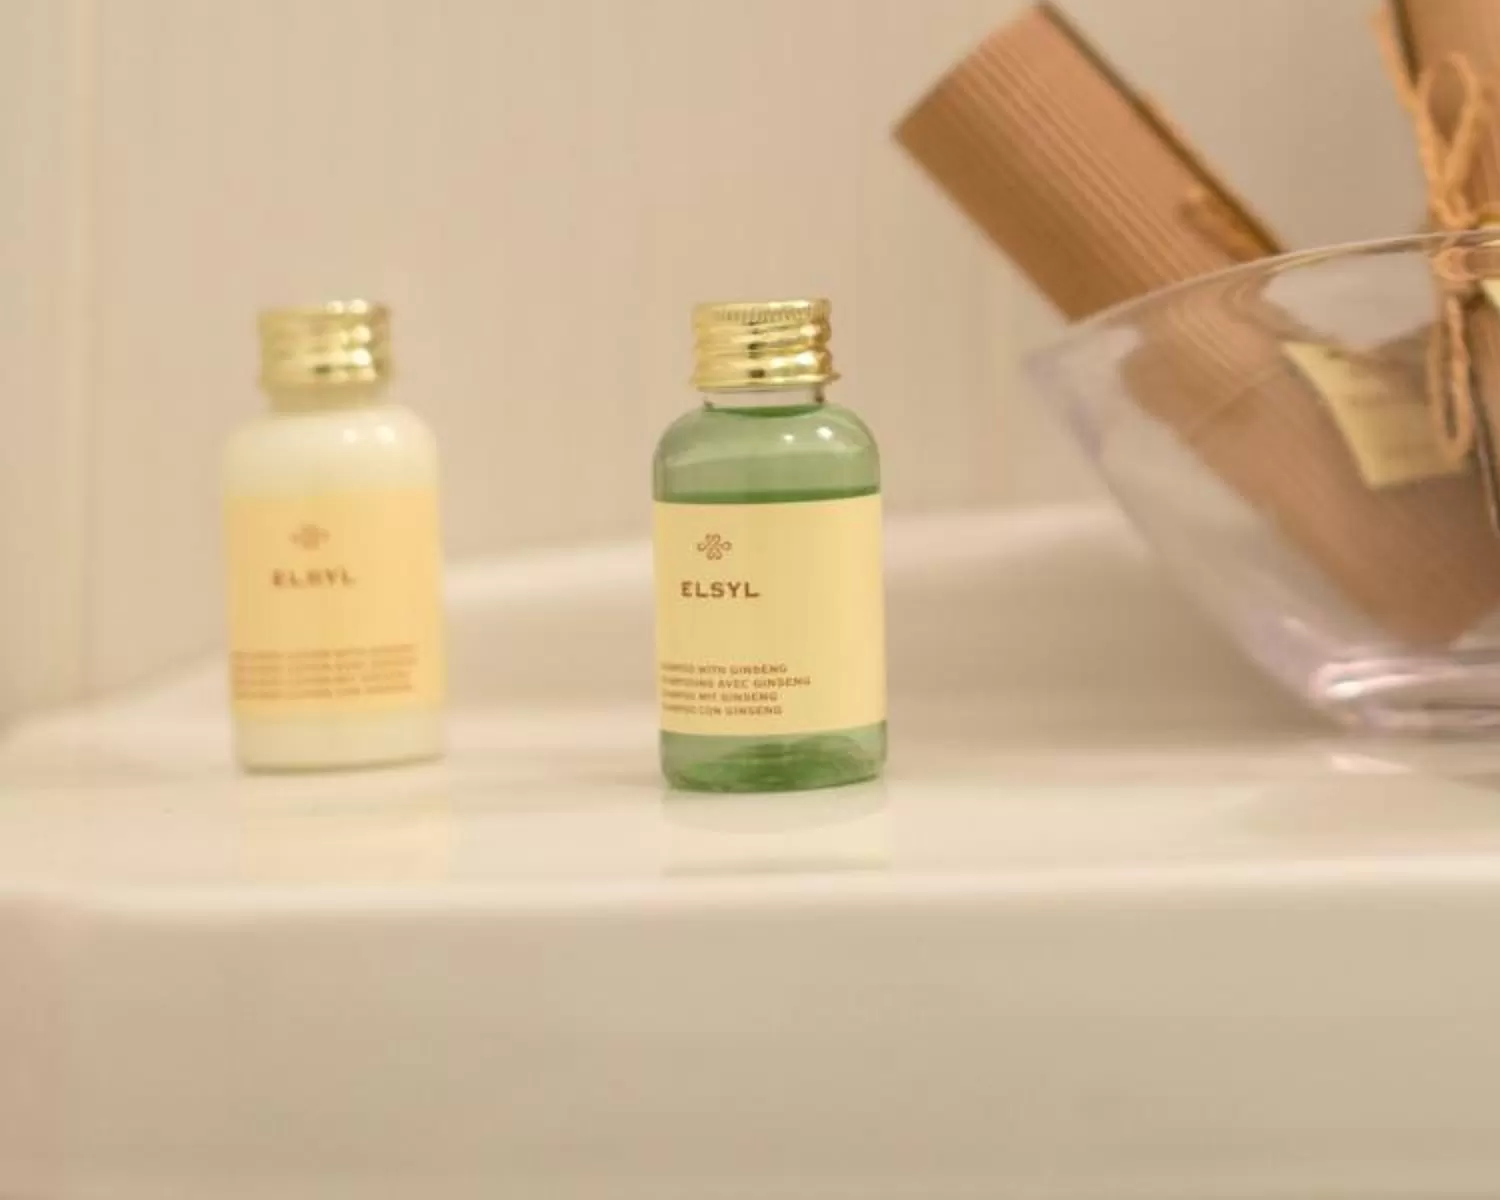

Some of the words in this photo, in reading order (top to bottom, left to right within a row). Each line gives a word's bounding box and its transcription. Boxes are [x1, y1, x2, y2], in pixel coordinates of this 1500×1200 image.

[681, 580, 760, 598] ELSYL
[729, 663, 788, 675] GINSENG
[717, 678, 750, 689] AVEC
[753, 675, 812, 689] GINSENG
[720, 691, 778, 702] GINSENG
[698, 704, 722, 716] CON
[724, 704, 783, 716] GINSENG
